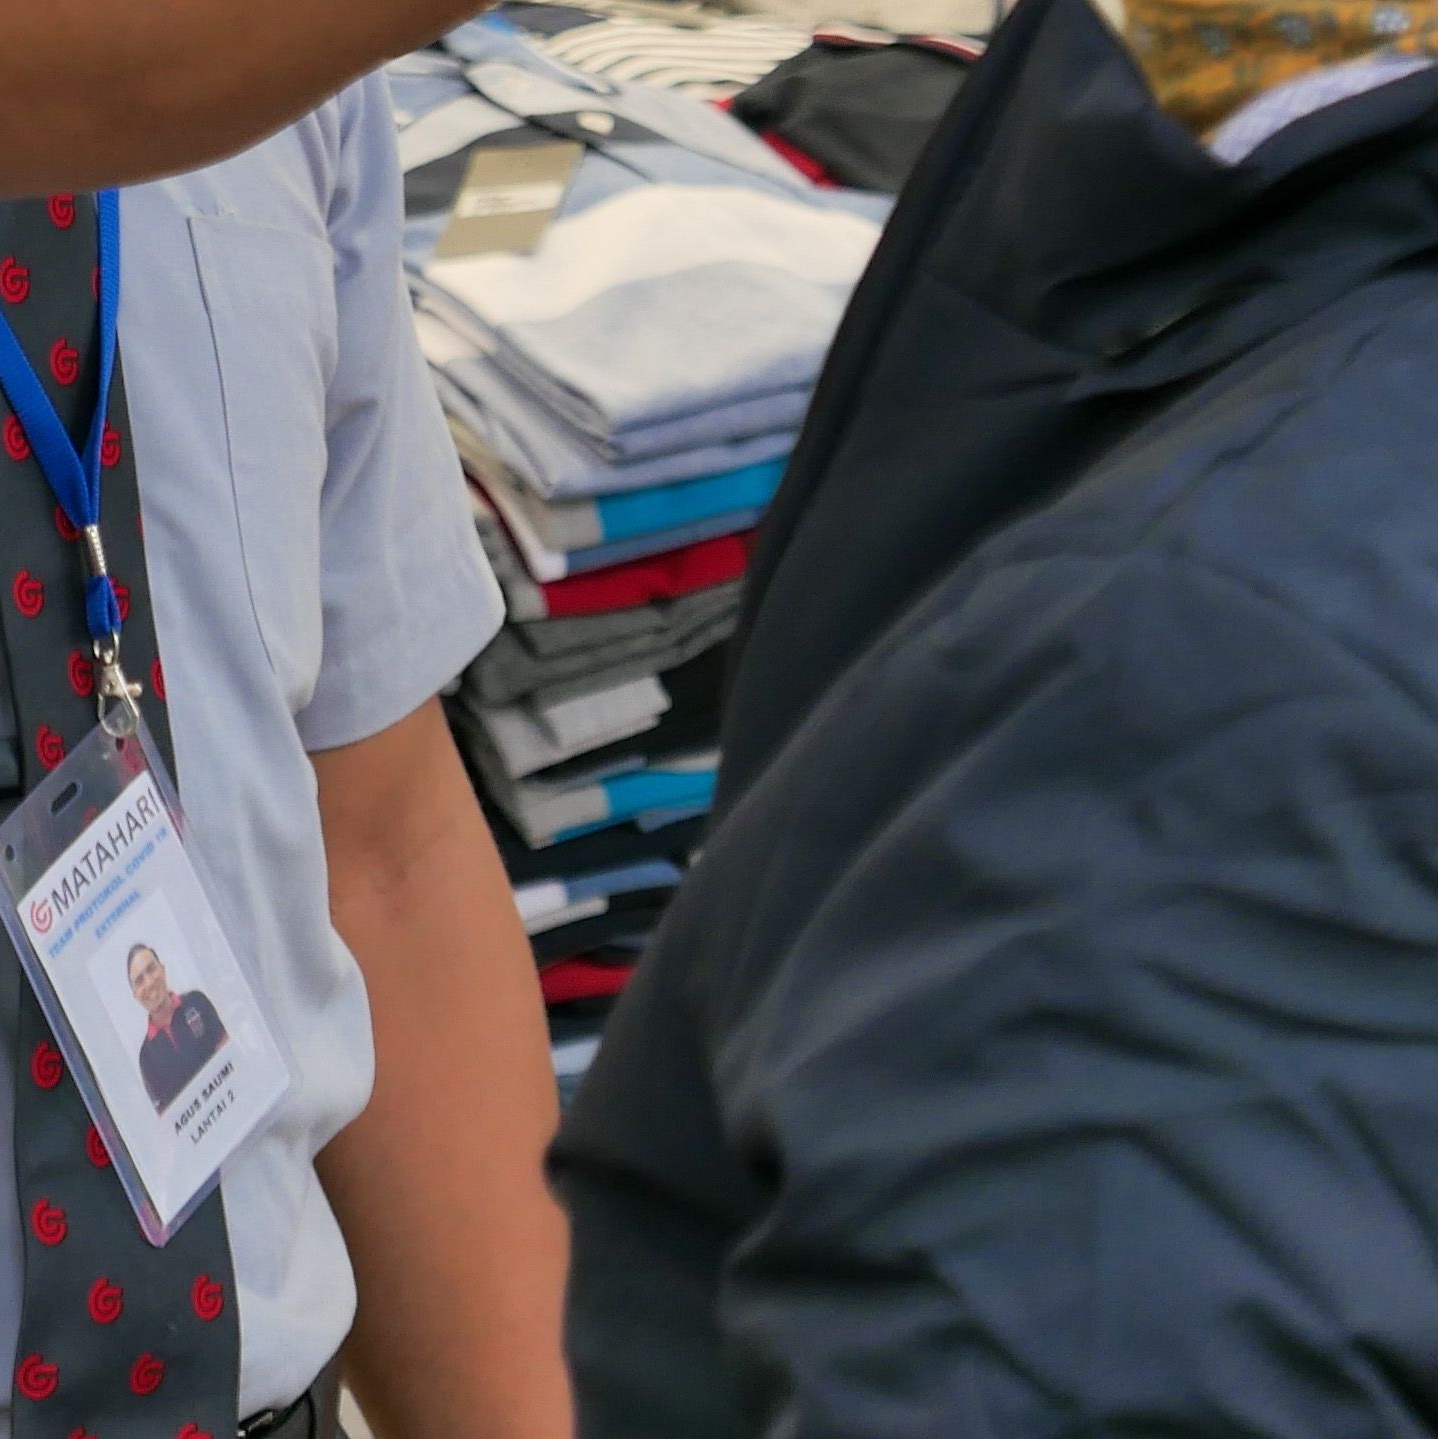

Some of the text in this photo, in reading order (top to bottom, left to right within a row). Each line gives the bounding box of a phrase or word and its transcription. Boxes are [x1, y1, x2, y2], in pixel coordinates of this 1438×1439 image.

[51, 787, 161, 917] MATAHARI
[174, 1098, 201, 1136] AGUS
[190, 1088, 236, 1144] LANTAI 2
